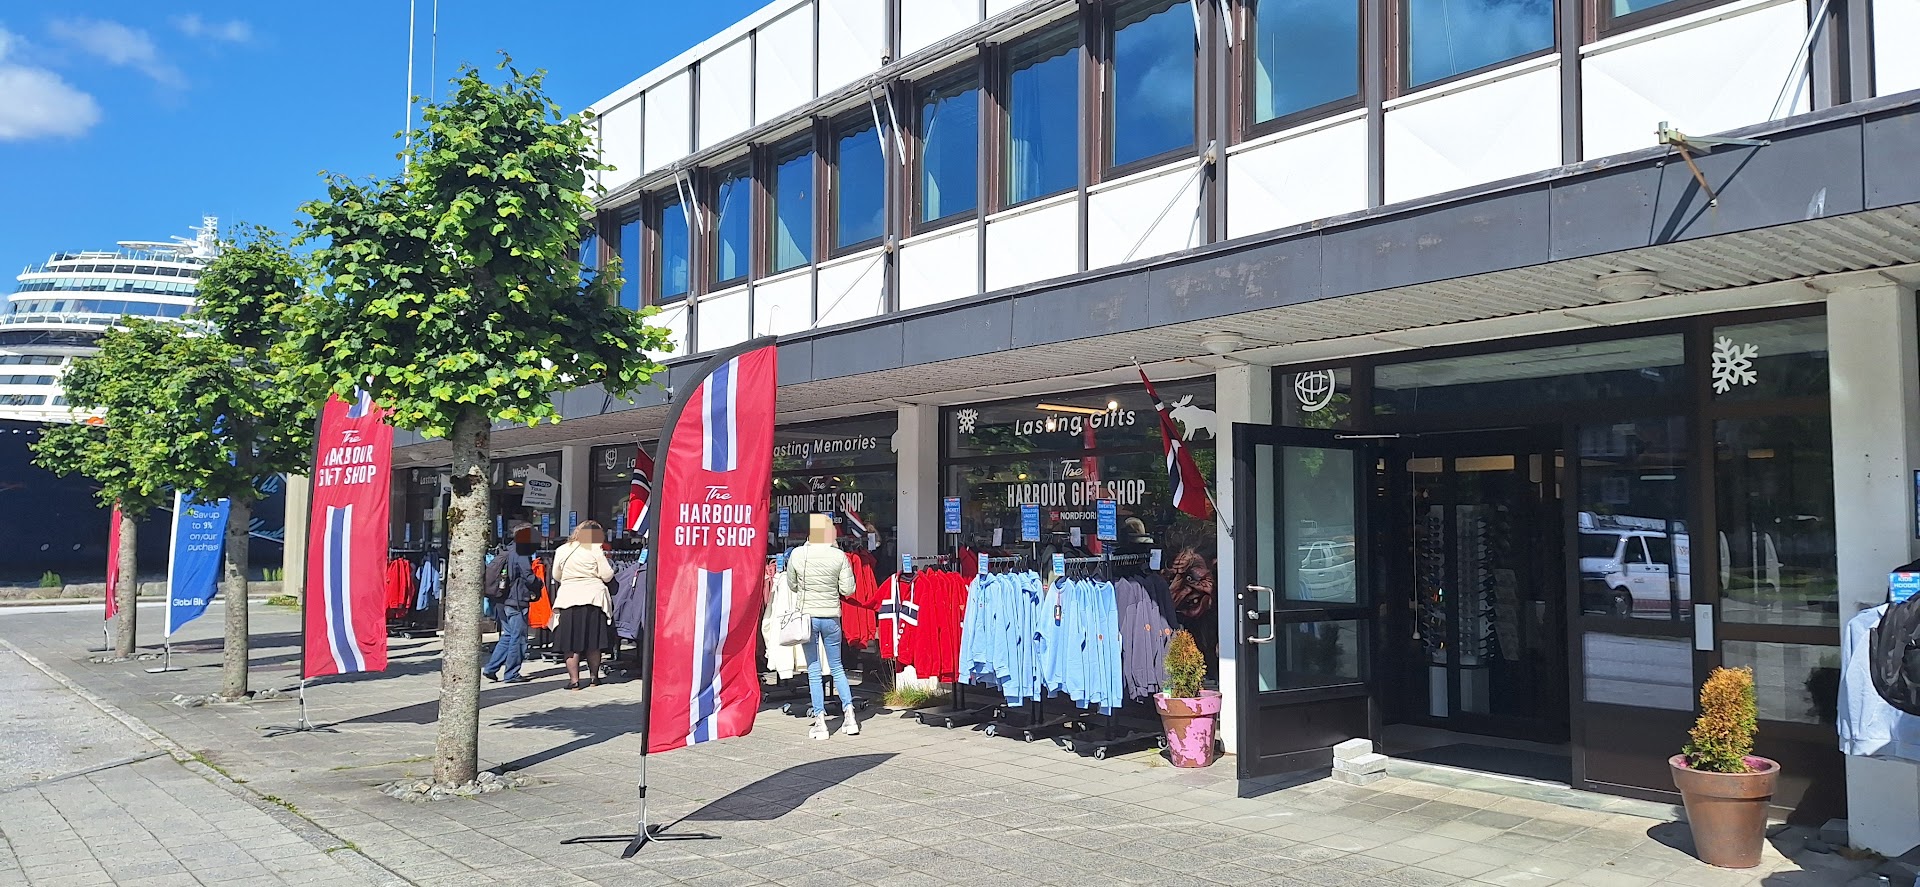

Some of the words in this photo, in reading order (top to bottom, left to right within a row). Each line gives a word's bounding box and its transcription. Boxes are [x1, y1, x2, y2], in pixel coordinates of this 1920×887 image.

[1014, 413, 1082, 437] Lasting
[1089, 408, 1136, 429] Gifts
[341, 429, 362, 446] The
[773, 440, 810, 459] asting
[813, 434, 877, 454] Memories
[343, 464, 377, 485] SHOP
[512, 466, 529, 479] Welco
[1060, 459, 1083, 480] The
[419, 474, 438, 486] Lasting
[808, 475, 827, 493] The
[705, 485, 732, 503] The
[1007, 482, 1067, 508] HARBOUR
[1071, 480, 1102, 506] GIFT
[1107, 479, 1146, 505] SHOP
[776, 494, 815, 515] HARBOUR
[817, 493, 837, 513] GIFT
[839, 492, 864, 513] SHOP
[679, 503, 752, 525] HARBOUR
[1060, 511, 1097, 520] NORDFJOR
[191, 522, 201, 530] to
[675, 525, 710, 546] GIFT
[716, 526, 756, 547] SHOP
[192, 597, 206, 606] Bl
